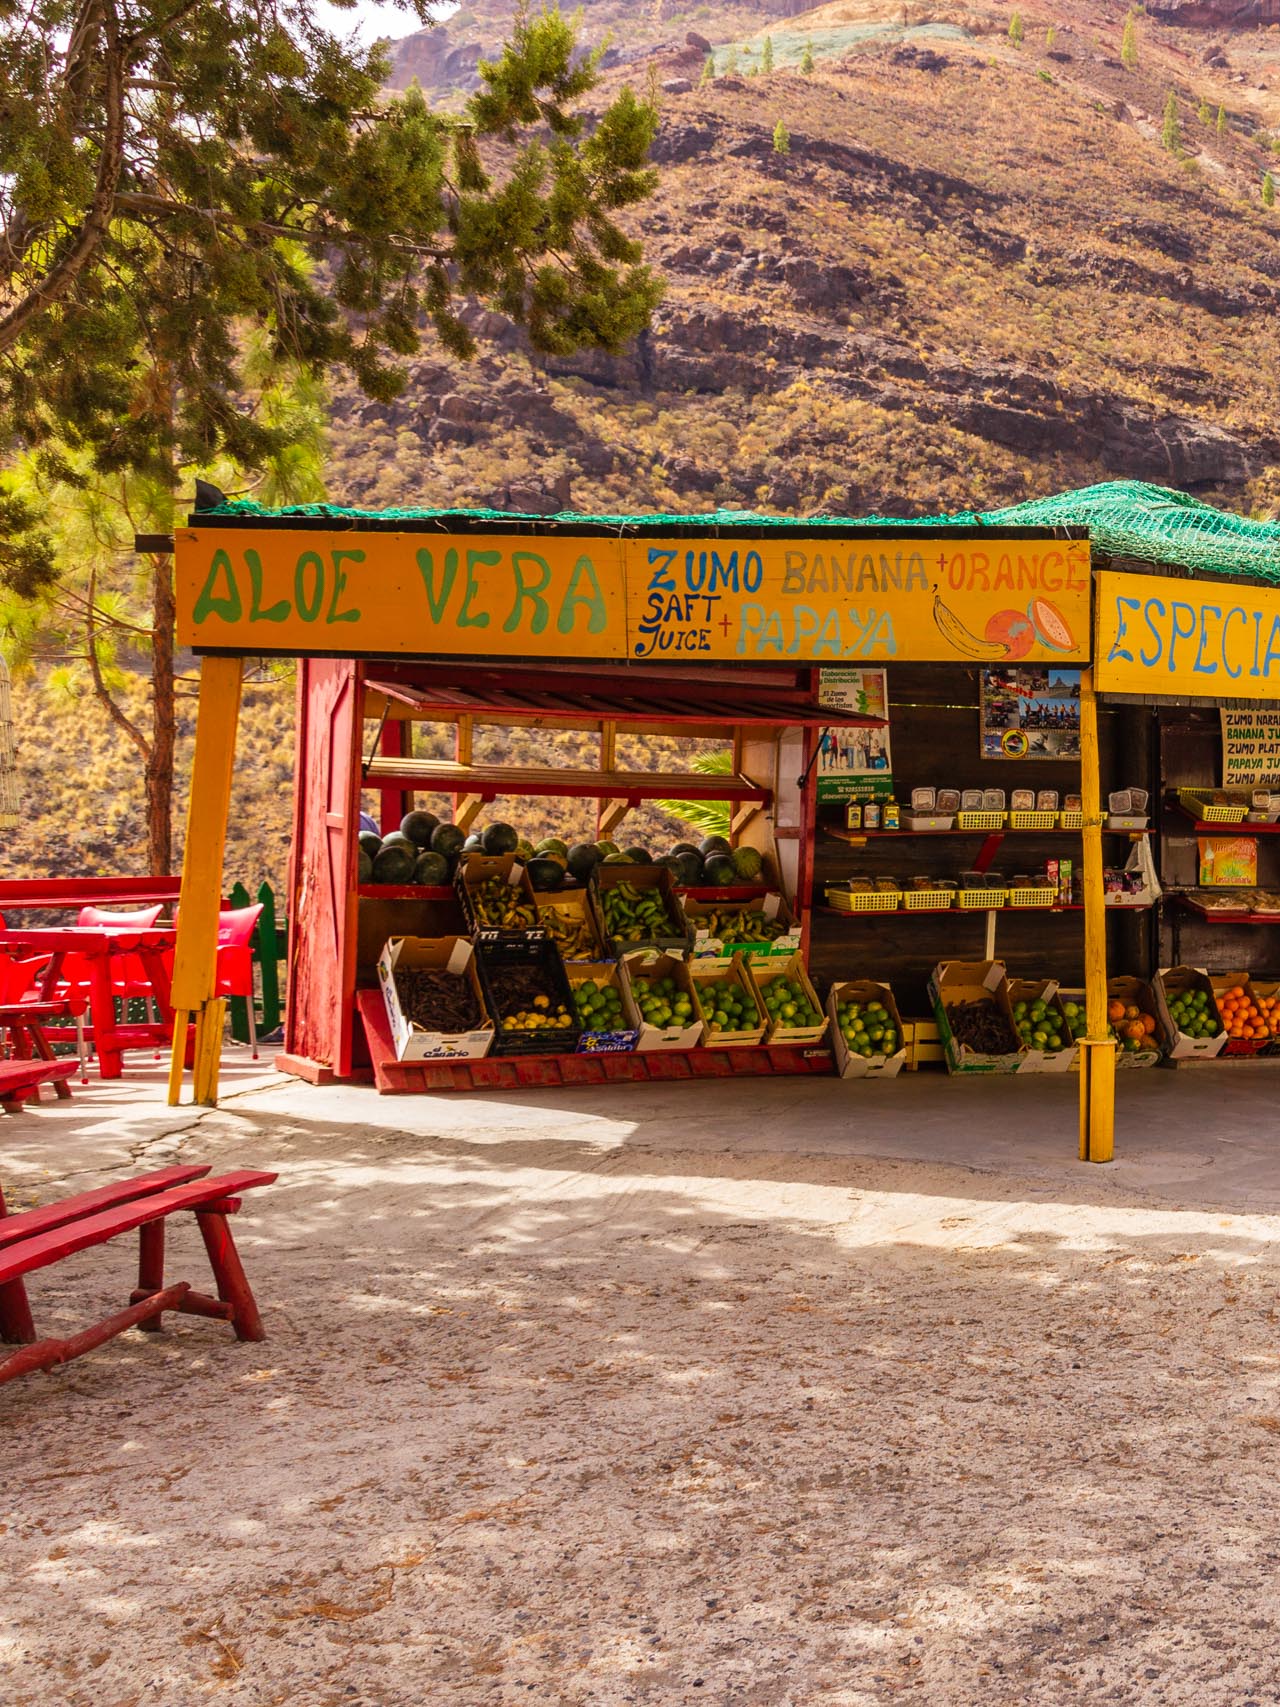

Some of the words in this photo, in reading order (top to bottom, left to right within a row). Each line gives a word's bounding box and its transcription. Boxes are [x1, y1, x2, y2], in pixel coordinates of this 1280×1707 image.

[647, 547, 763, 593] ZUMO
[781, 550, 929, 594] BANANA
[948, 551, 1088, 593] ORANGE
[192, 548, 366, 625] ALOE
[415, 547, 607, 635] VERA
[642, 593, 721, 625] SAFT
[736, 602, 897, 656] PAPAYA
[634, 625, 711, 658] JUICE
[1226, 715, 1252, 725] ZUMO
[1227, 728, 1264, 740] BANANA
[1227, 743, 1255, 754] ZUMO
[1227, 758, 1263, 769] PAPAYA
[1226, 773, 1255, 785] ZUMO
[423, 1050, 469, 1058] Canario
